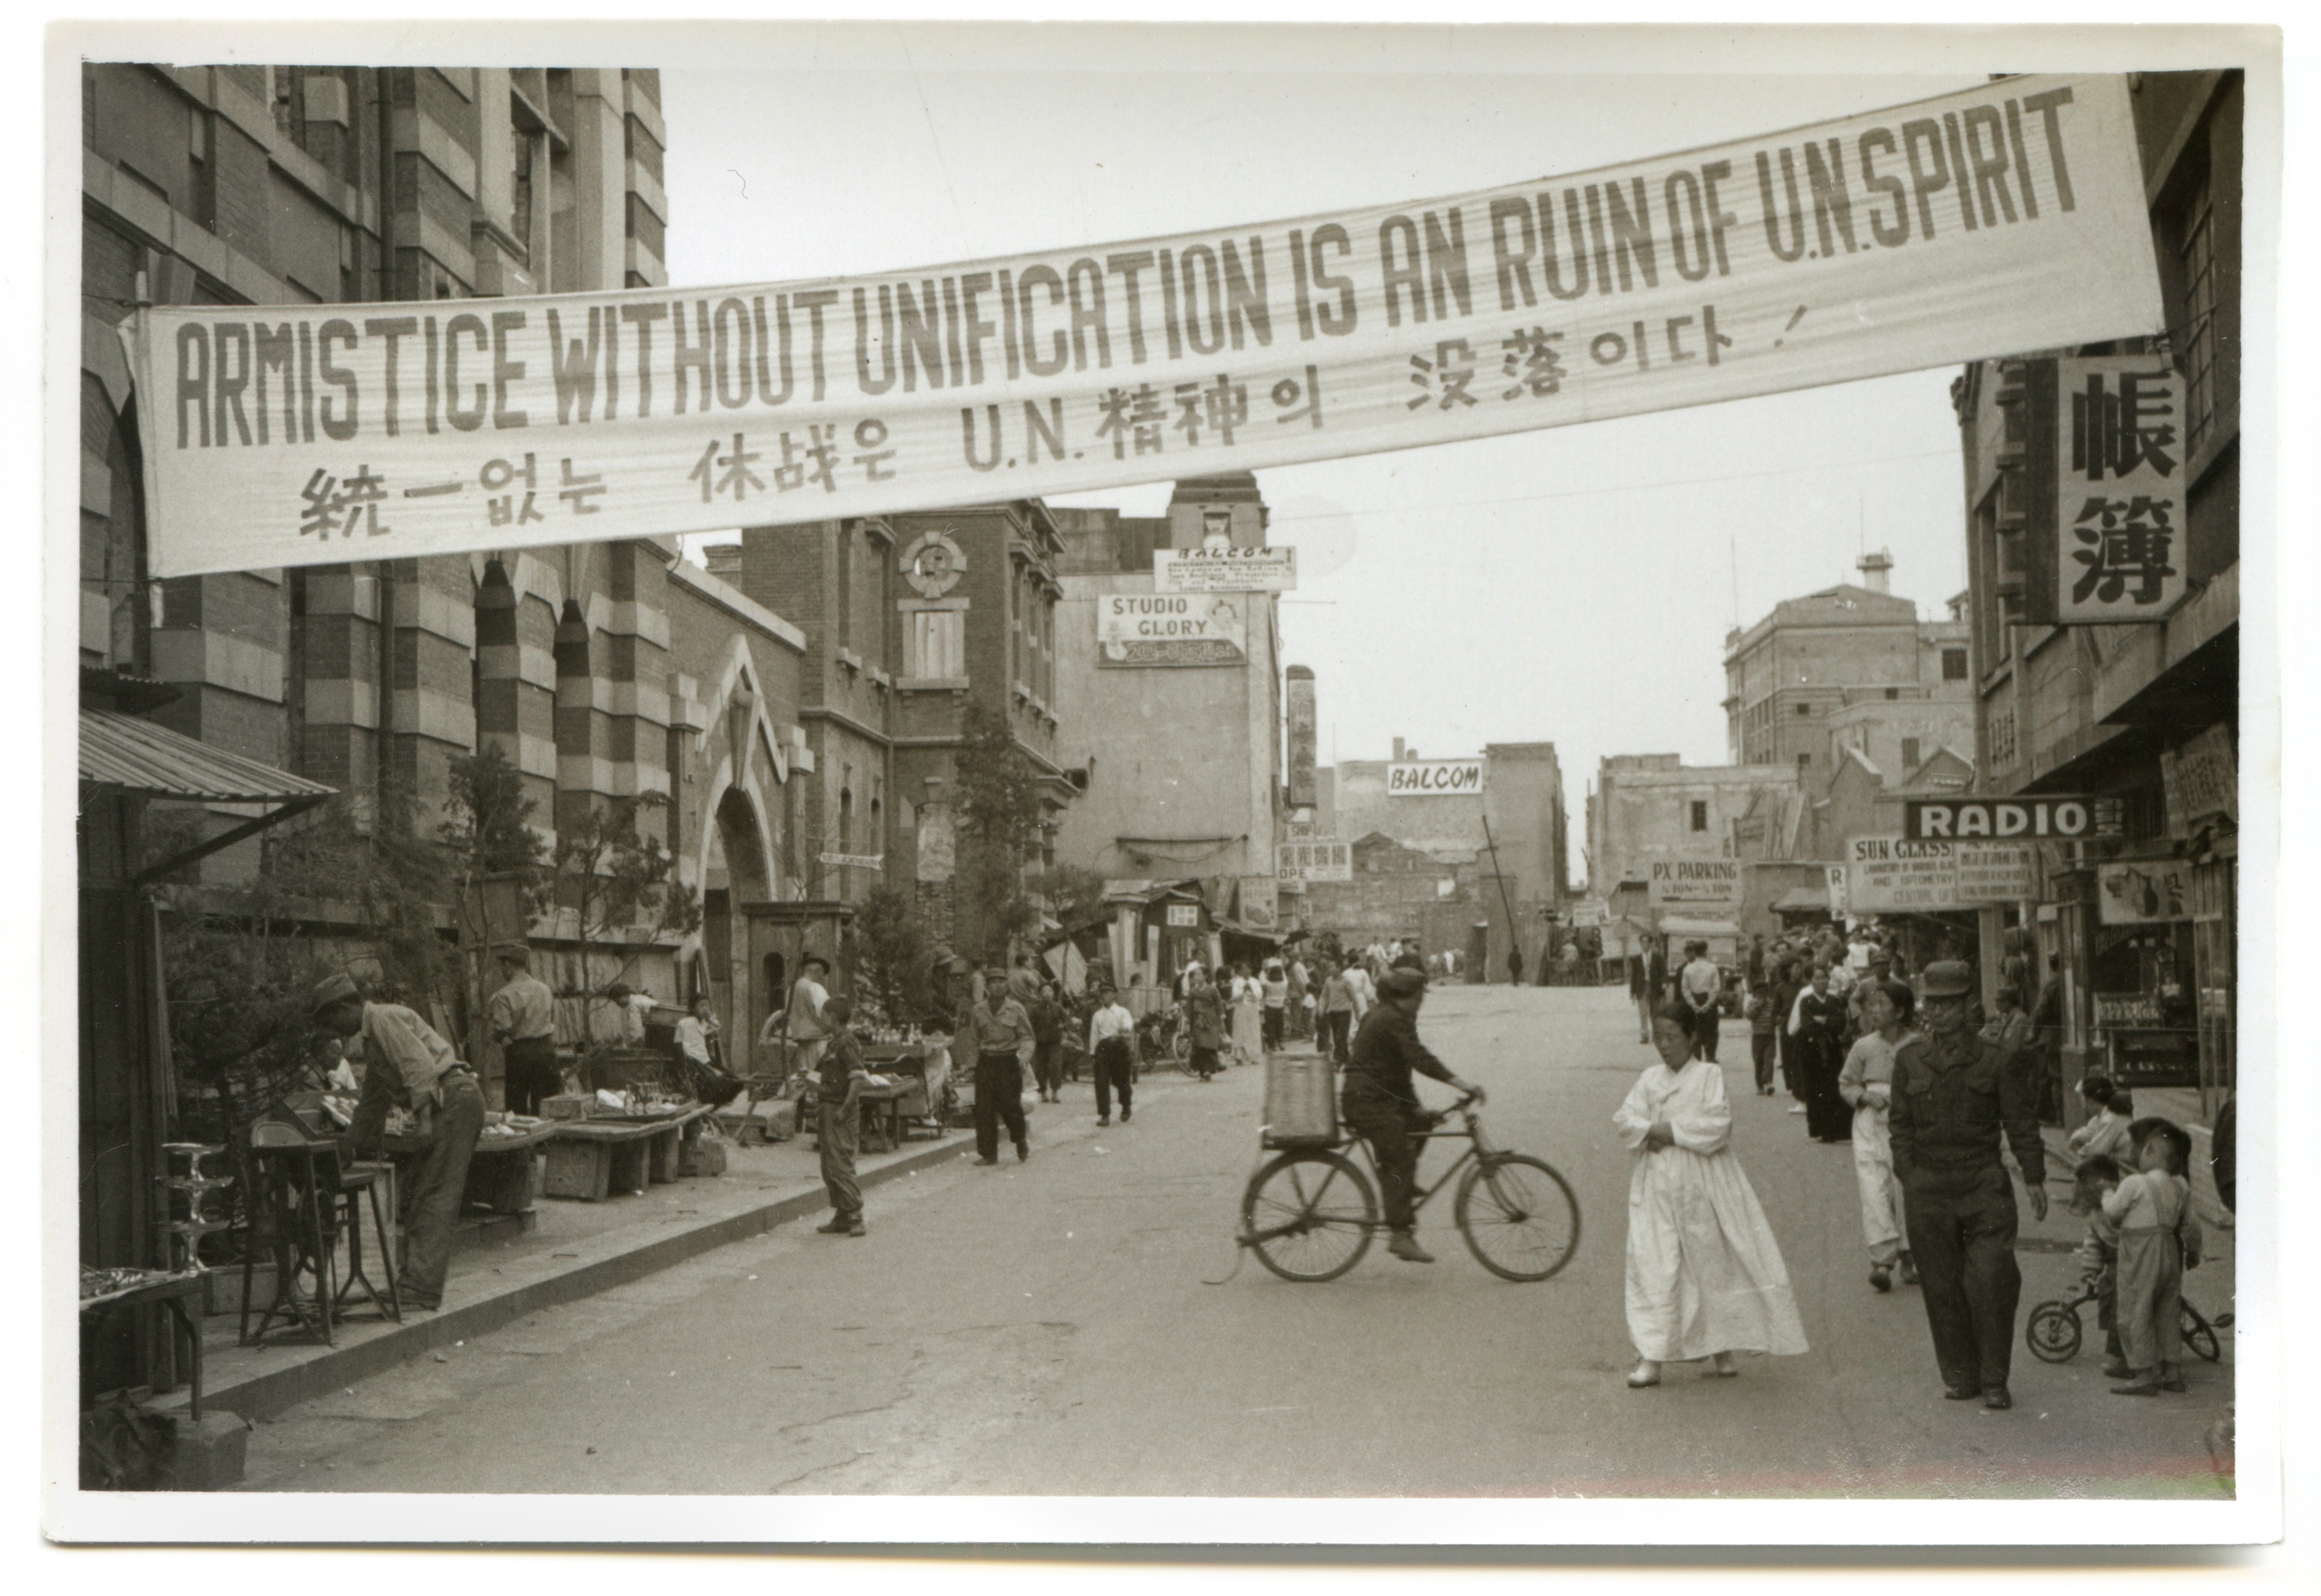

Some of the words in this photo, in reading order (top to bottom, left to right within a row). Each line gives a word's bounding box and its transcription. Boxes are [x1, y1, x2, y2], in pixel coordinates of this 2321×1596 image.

[175, 311, 528, 449] ARMISTICE
[547, 290, 838, 425] WITHOUT
[854, 236, 1272, 395] UNIFICATION
[1289, 223, 1358, 341] IS
[1378, 206, 1472, 328] AN
[1490, 177, 1659, 310] RUIN
[1664, 160, 1736, 282] OF
[2072, 370, 2179, 604] 帳簿
[1179, 547, 1272, 558] BALCOM
[1113, 598, 1187, 615] STUDIO
[1138, 620, 1207, 635] GLORY
[1391, 766, 1480, 790] BALCOM
[1920, 802, 2088, 837] RADIO
[1856, 840, 1889, 861] SUN
[1653, 863, 1671, 880] PX
[1678, 862, 1737, 880] PARKING
[1713, 884, 1732, 894] TON
[1873, 877, 1891, 887] AND
